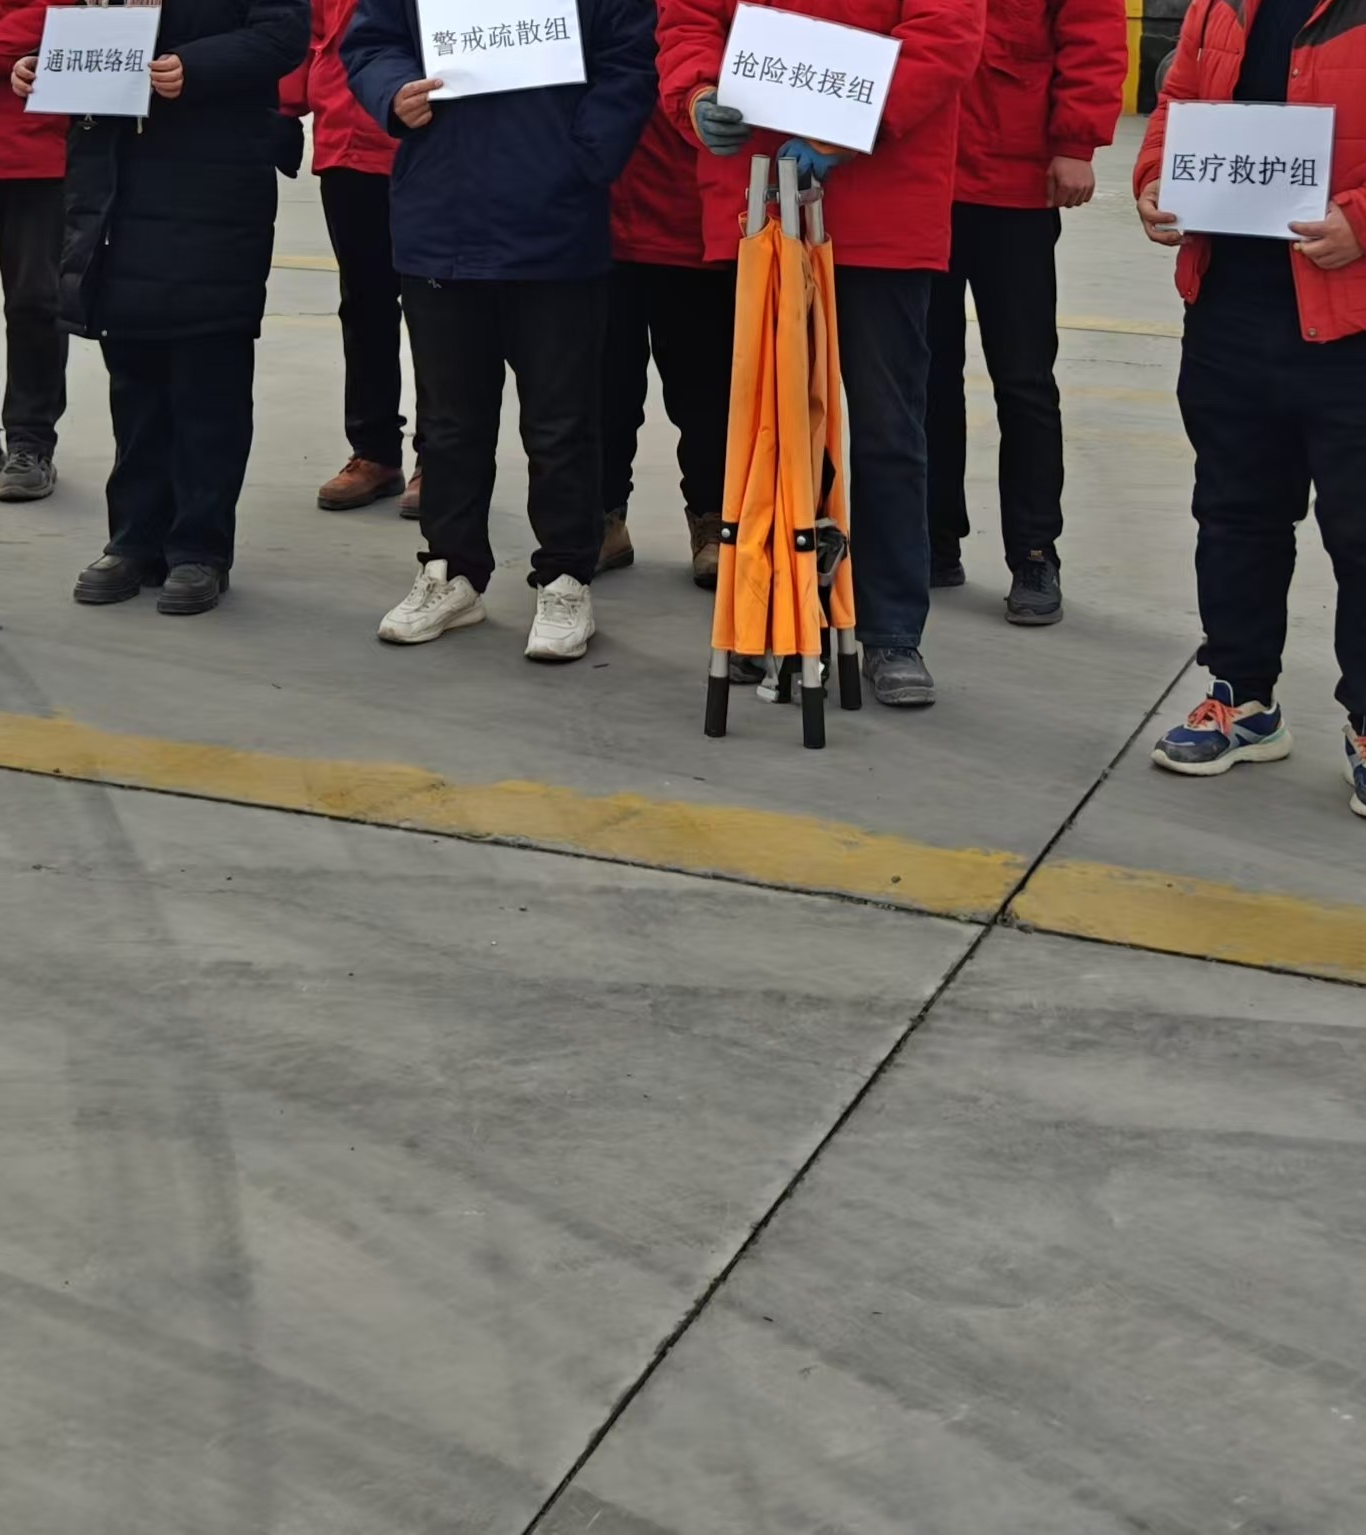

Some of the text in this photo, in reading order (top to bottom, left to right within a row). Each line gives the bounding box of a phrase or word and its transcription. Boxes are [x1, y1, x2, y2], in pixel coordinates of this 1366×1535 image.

[432, 16, 571, 56] 警戒疏散组
[43, 47, 144, 73] 通讯联络组
[731, 49, 874, 105] 抢险救援组
[1172, 153, 1318, 187] 医疗救护组
